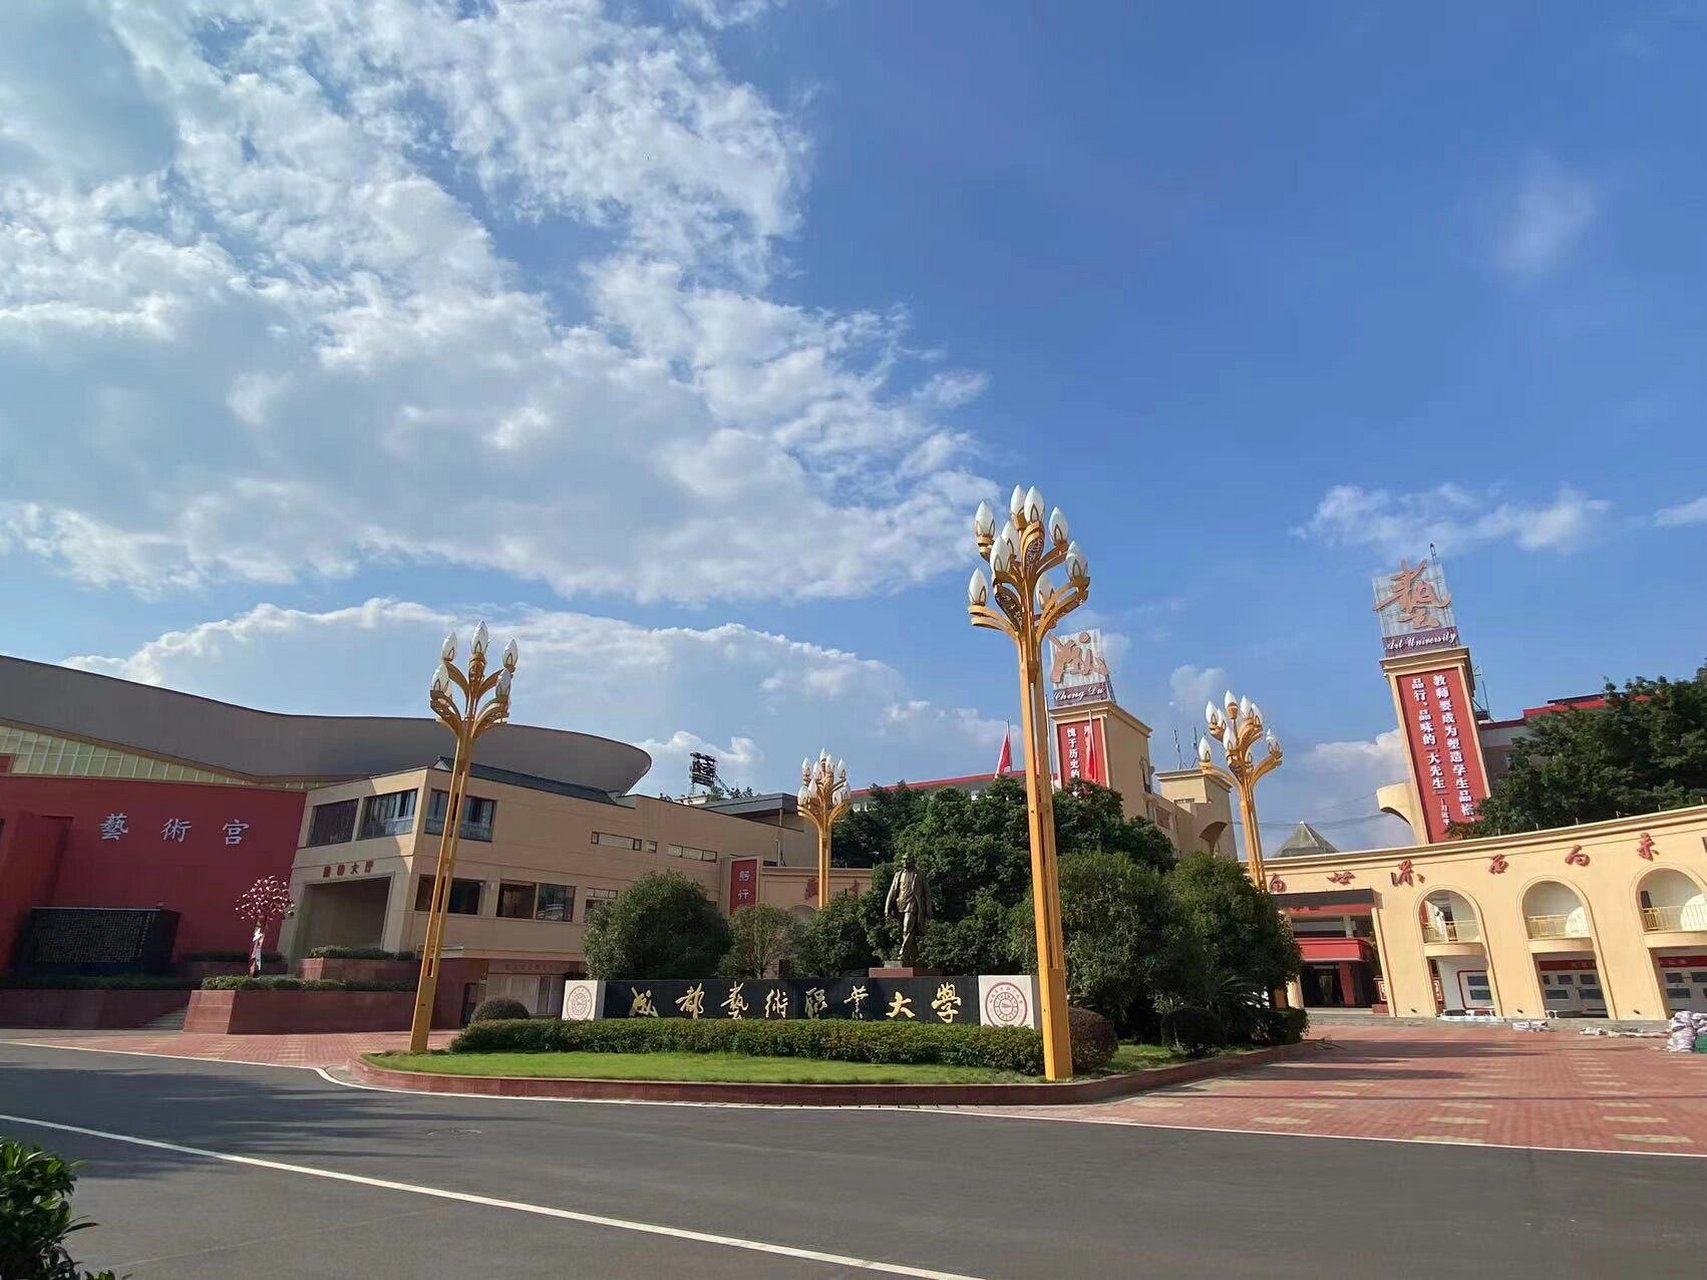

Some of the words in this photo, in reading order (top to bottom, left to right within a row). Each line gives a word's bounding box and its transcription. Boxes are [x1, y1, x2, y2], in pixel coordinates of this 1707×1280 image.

[1405, 631, 1456, 647] University
[1054, 688, 1086, 701] Cheng
[1088, 686, 1104, 696] Du
